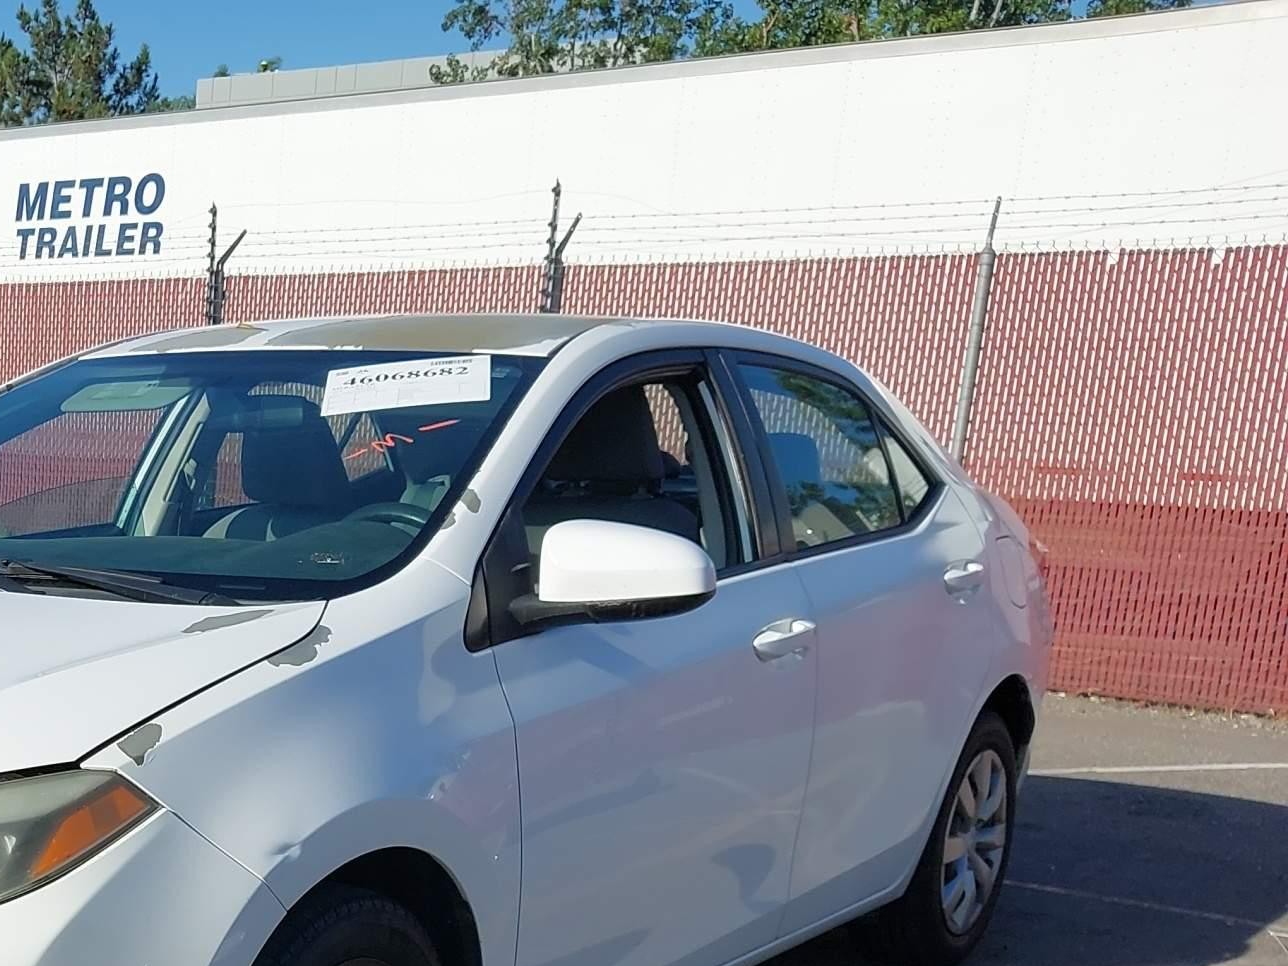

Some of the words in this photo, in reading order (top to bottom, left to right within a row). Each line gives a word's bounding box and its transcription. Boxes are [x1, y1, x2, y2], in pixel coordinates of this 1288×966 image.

[15, 173, 166, 222] METRO
[16, 221, 164, 260] TRAILER
[343, 366, 470, 386] 46068682
